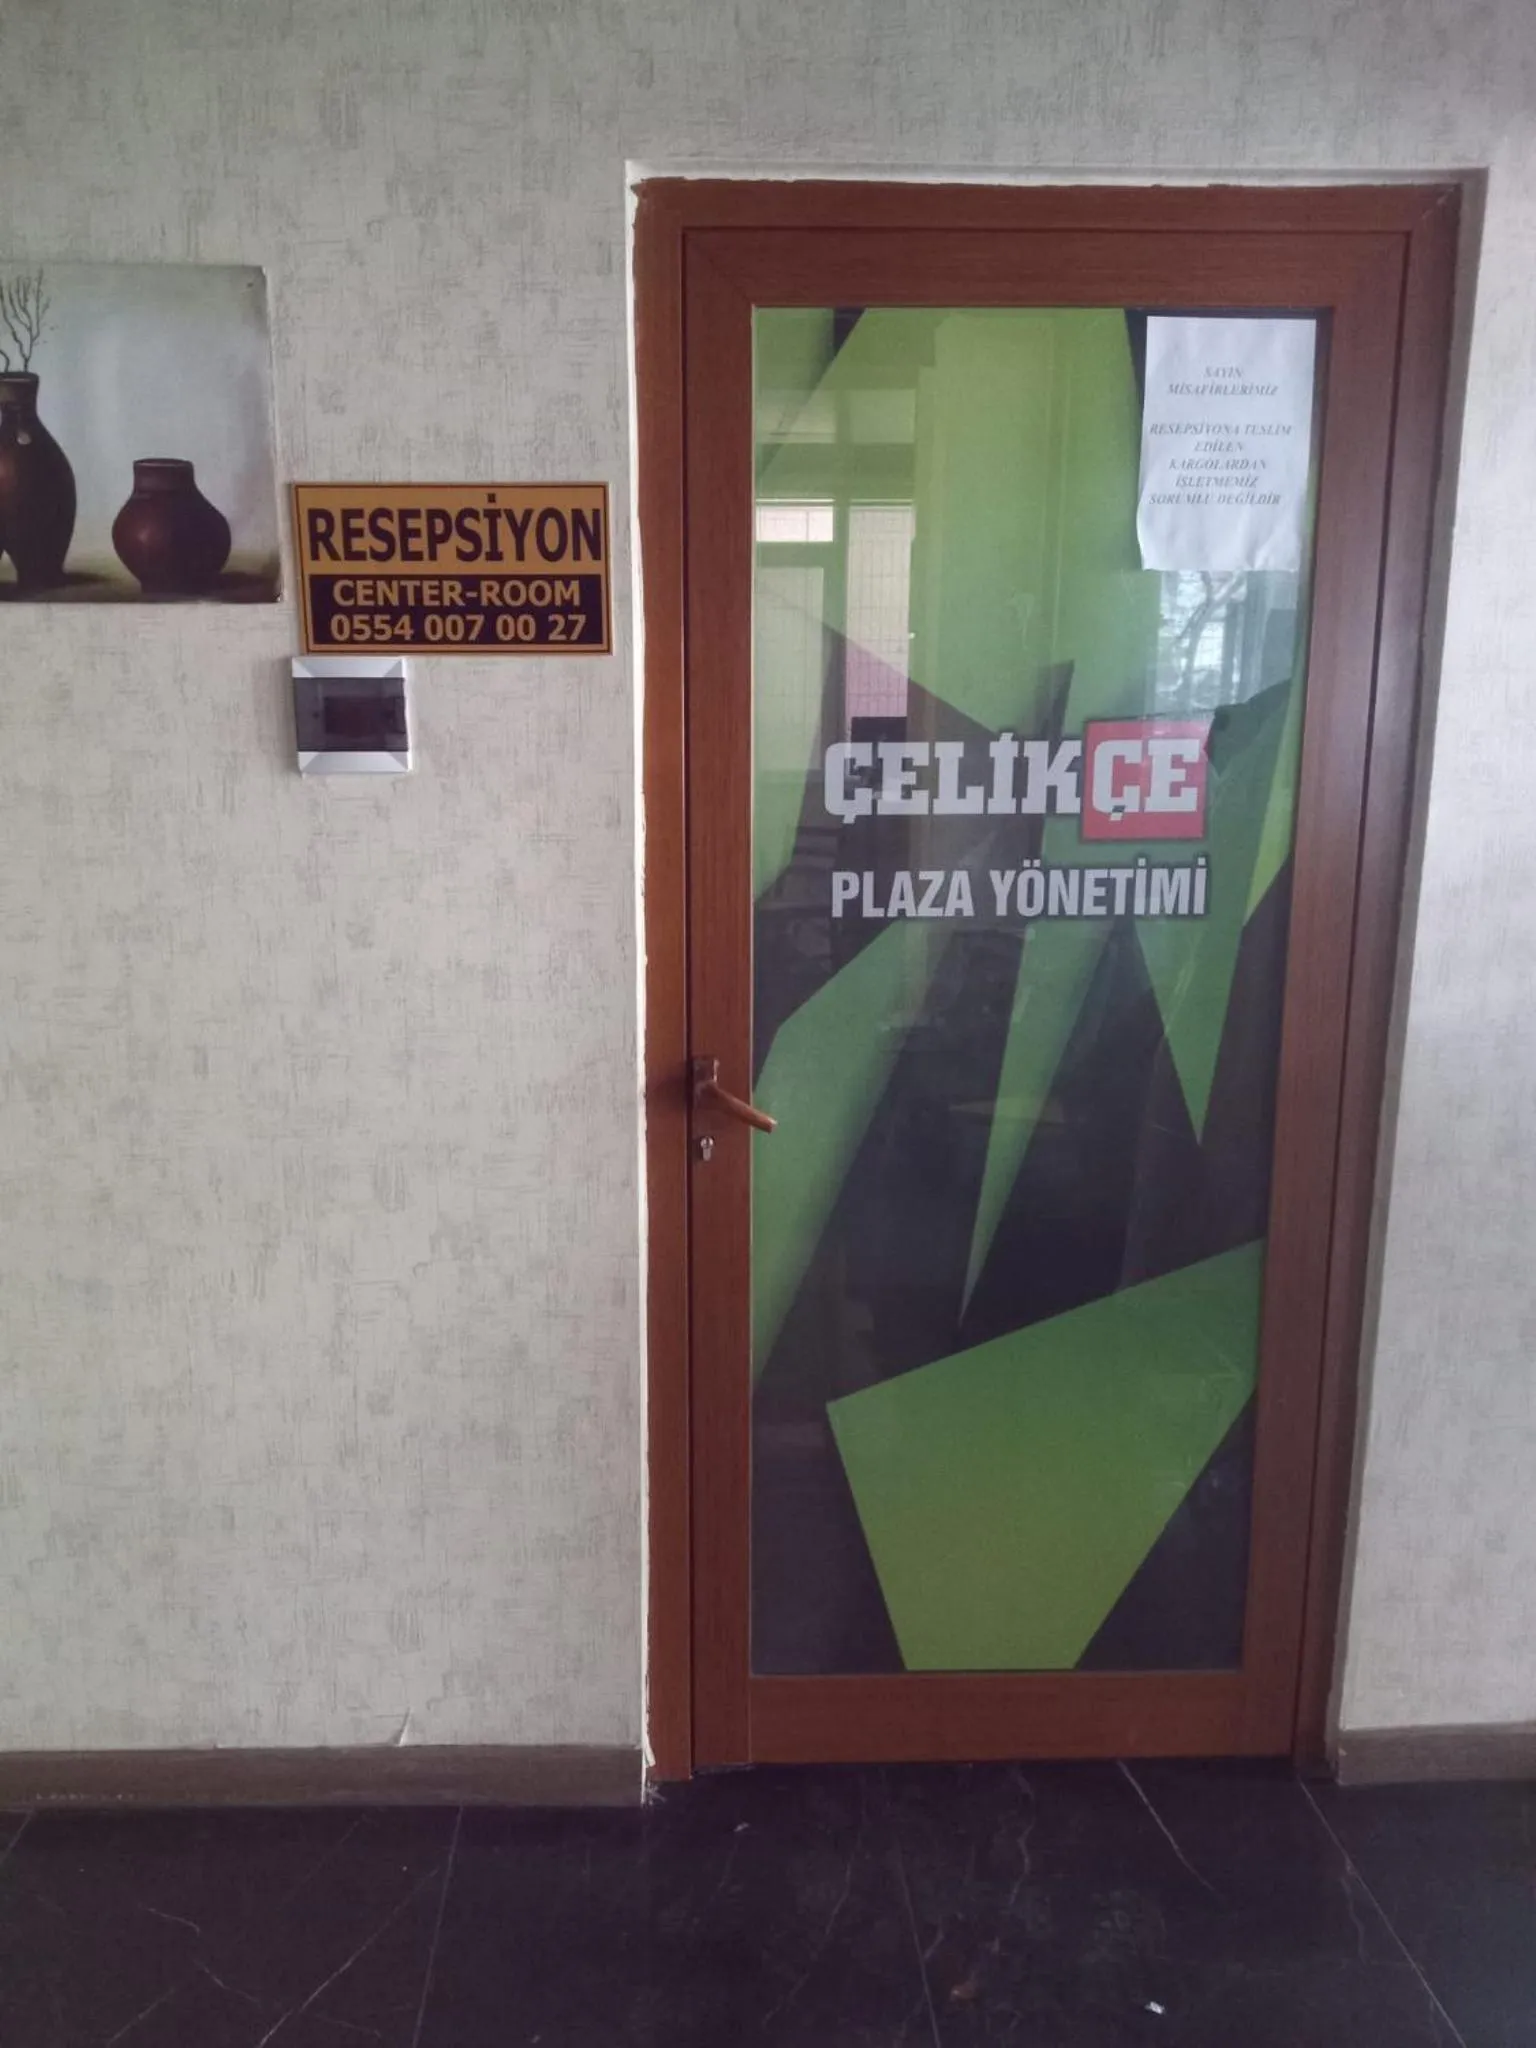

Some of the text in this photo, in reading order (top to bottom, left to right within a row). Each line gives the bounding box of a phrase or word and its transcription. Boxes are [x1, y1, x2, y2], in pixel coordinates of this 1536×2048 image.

[1150, 422, 1240, 436] RESEPSİYONA
[1193, 438, 1244, 453] EDİLEN
[307, 493, 601, 562] RESEPSİYON
[332, 579, 580, 607] CENTER-ROOM
[330, 614, 587, 641] 0554 007 00 27
[831, 857, 1208, 918] PLAZA YÖNETİMİ
